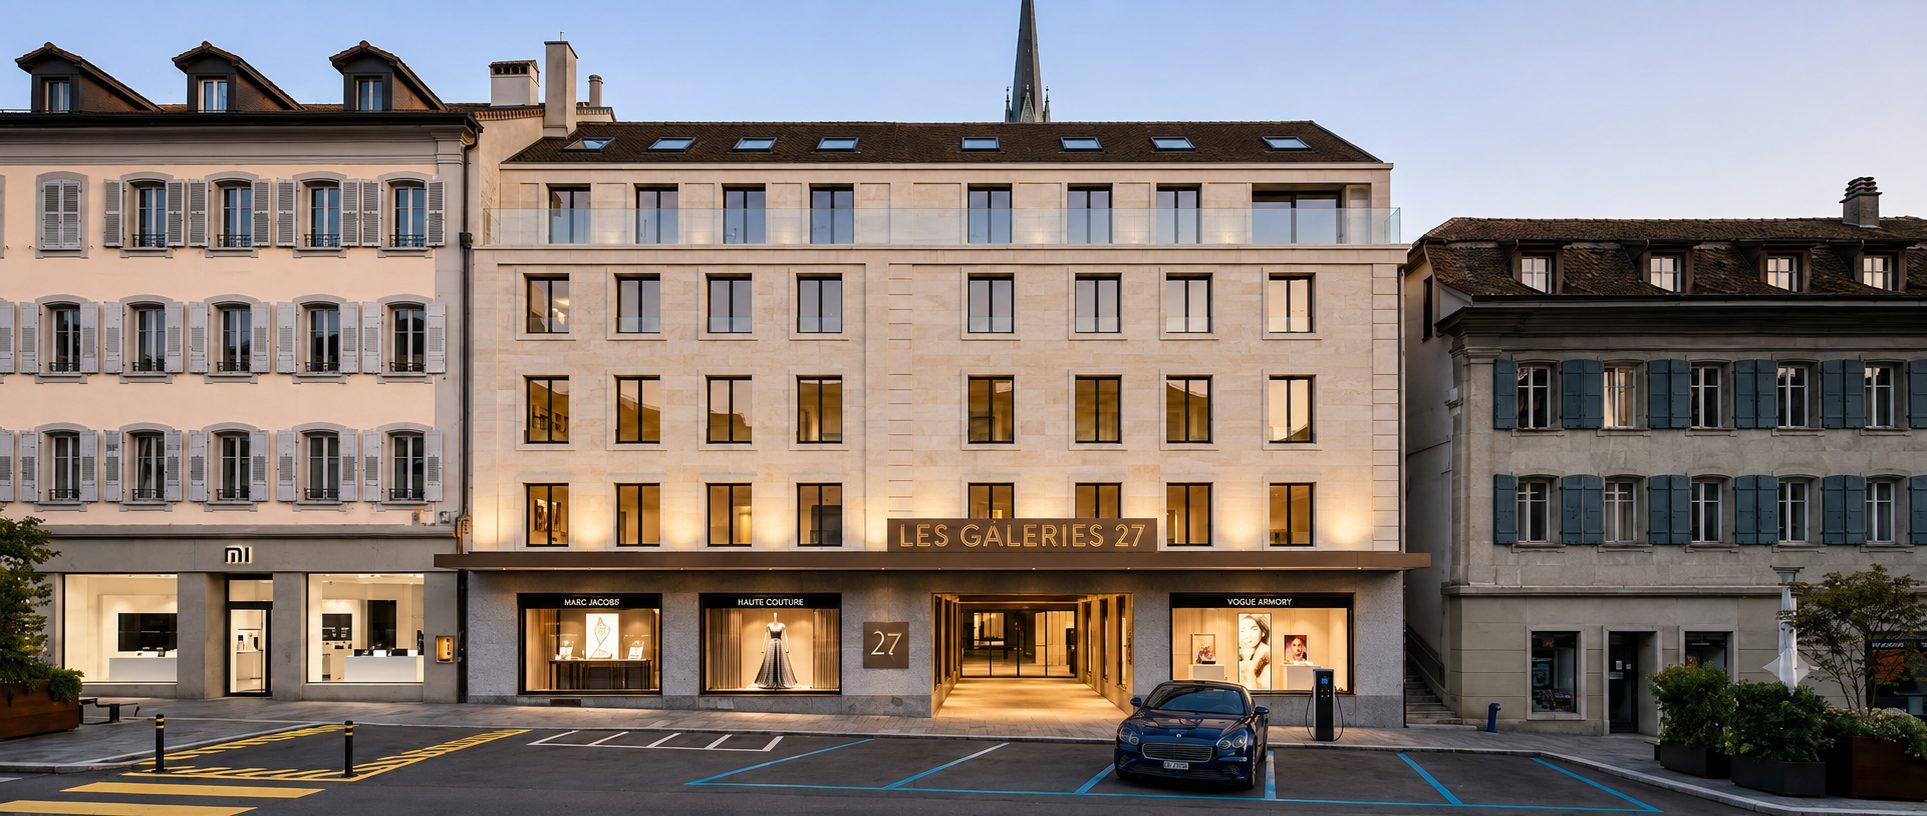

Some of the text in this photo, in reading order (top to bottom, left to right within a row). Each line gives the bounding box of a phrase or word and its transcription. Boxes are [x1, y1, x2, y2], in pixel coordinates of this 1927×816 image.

[900, 523, 949, 547] LES
[1114, 523, 1146, 547] 27
[564, 598, 587, 606] MARC
[737, 598, 804, 606] HAUTE COUTURE
[1227, 598, 1292, 606] VOGUE ARMORY
[871, 630, 902, 656] 27
